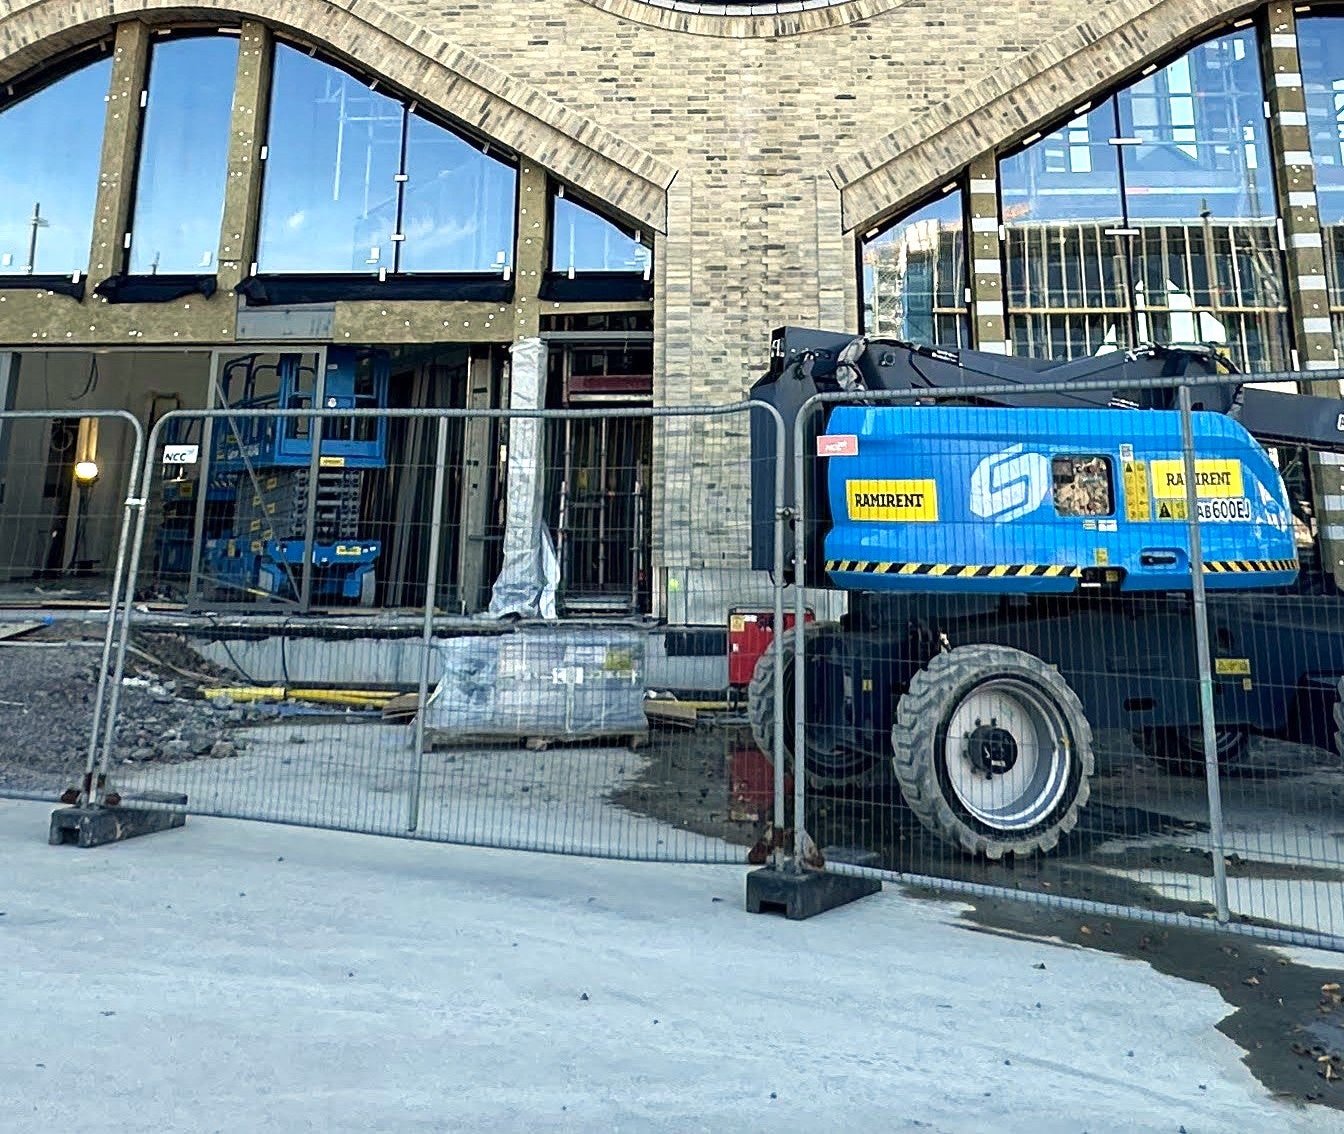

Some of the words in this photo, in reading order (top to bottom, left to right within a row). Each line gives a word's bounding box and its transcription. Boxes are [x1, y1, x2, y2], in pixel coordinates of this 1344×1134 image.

[165, 453, 186, 461] NCC
[1166, 472, 1231, 485] RAIRENT
[855, 493, 924, 508] RAMIRENT
